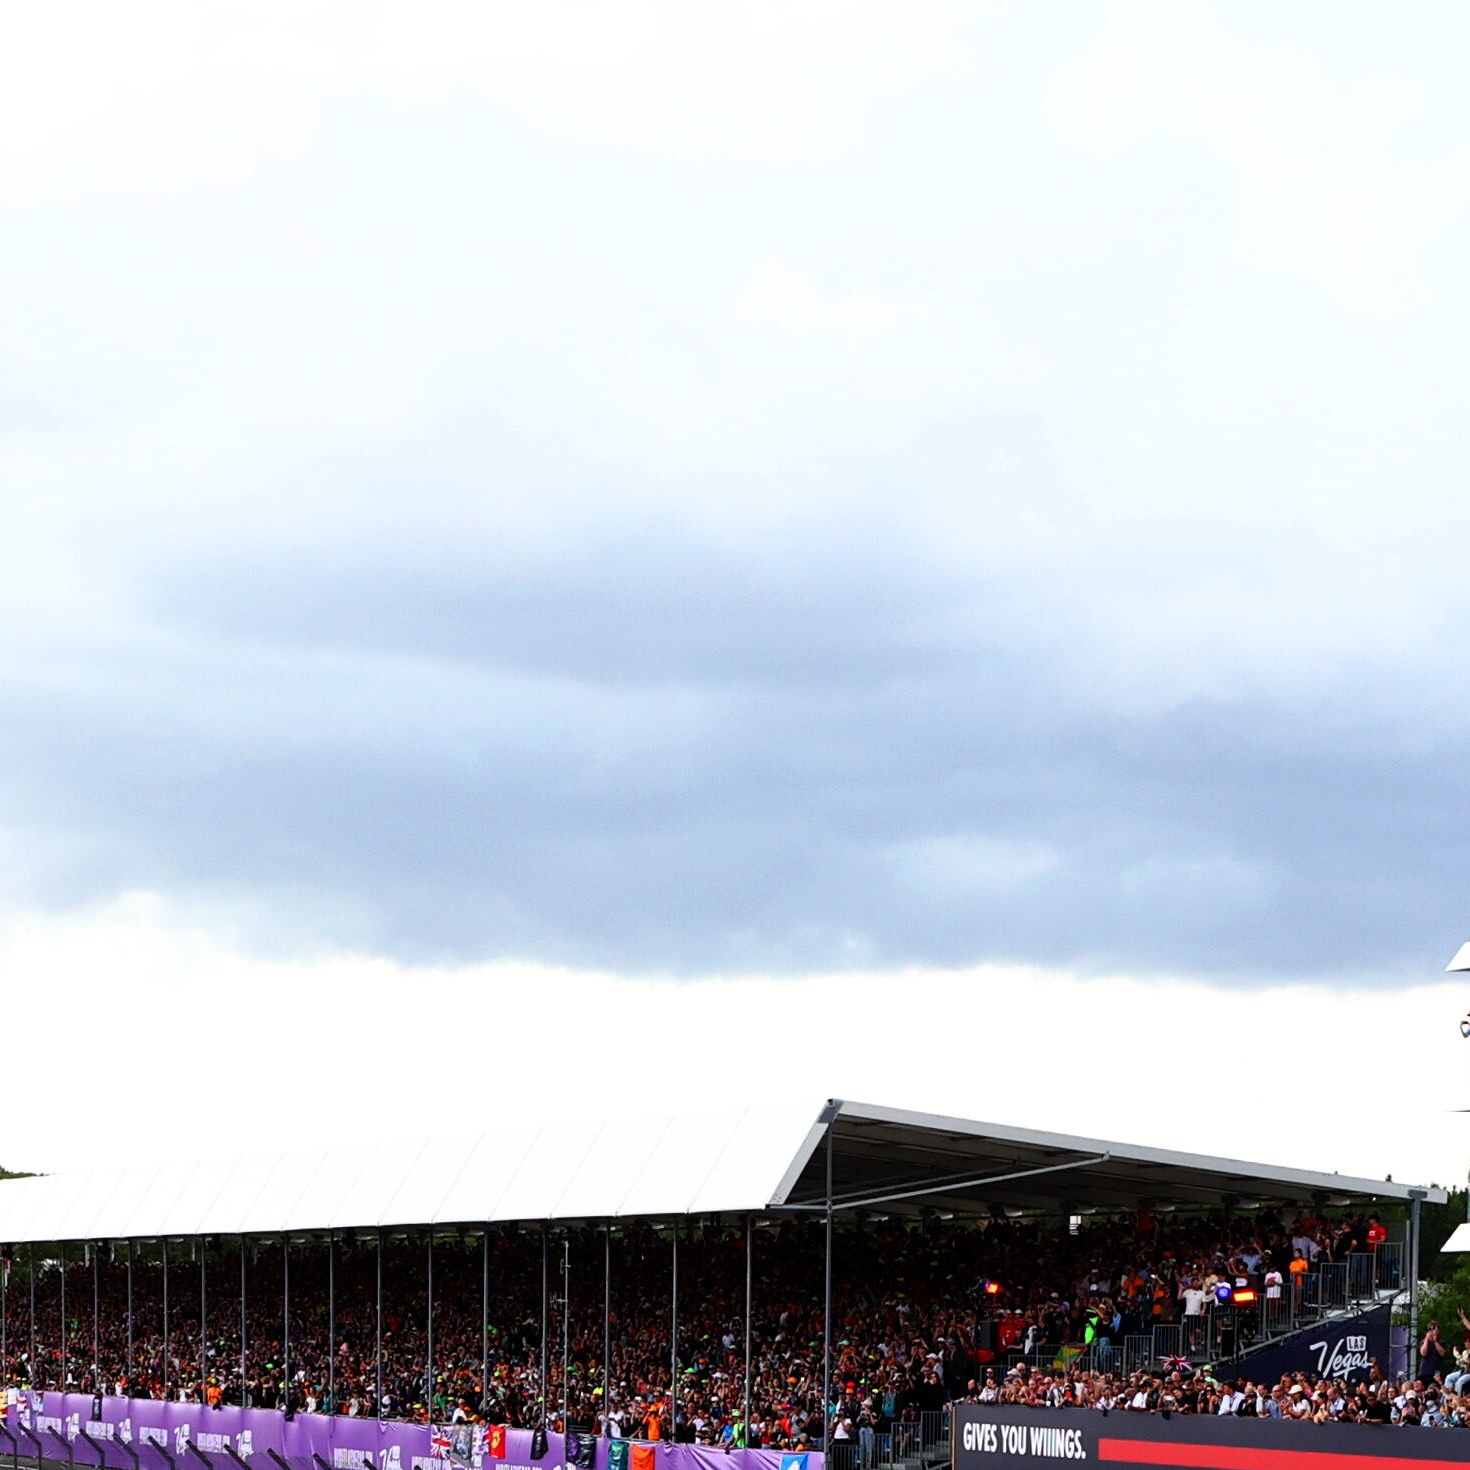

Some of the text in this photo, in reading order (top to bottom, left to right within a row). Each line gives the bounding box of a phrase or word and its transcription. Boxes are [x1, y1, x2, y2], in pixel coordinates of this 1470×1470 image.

[1310, 1336, 1373, 1381] LAS Vegas
[963, 1422, 997, 1453] GIVES
[1001, 1425, 1027, 1455] YOU
